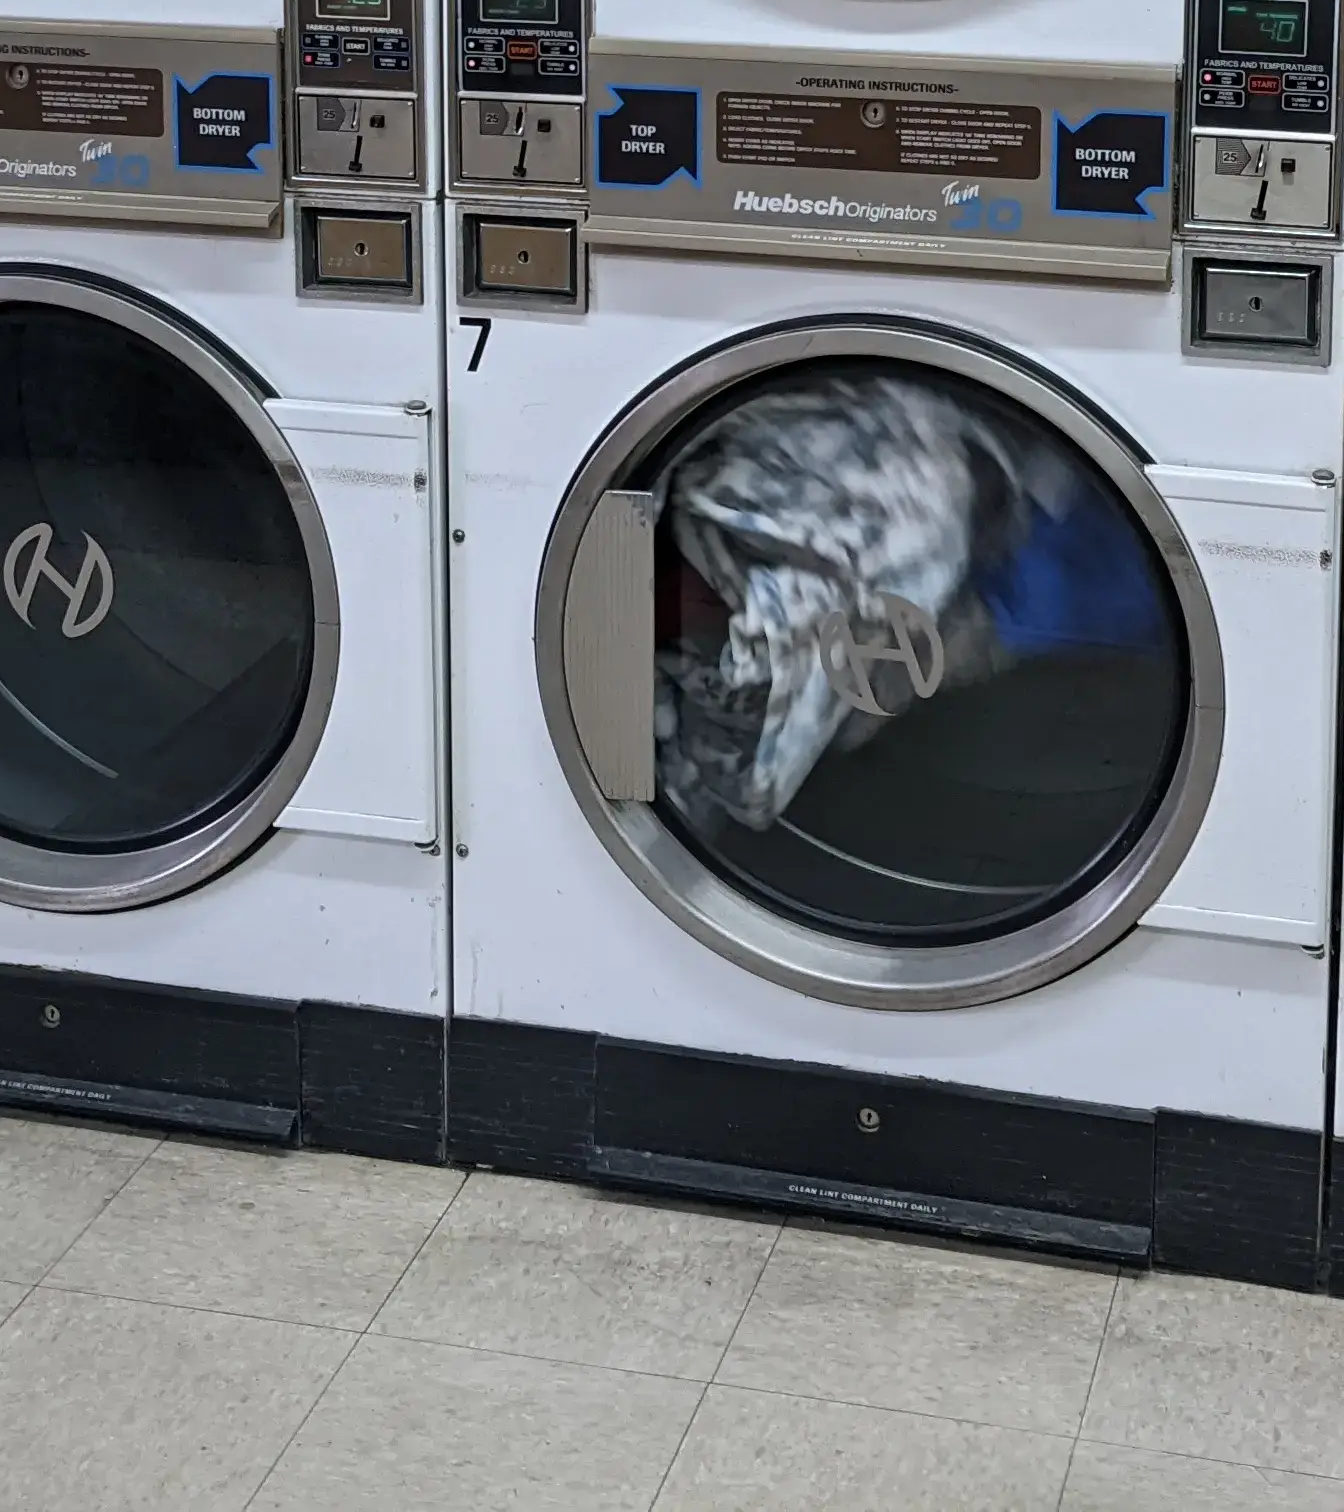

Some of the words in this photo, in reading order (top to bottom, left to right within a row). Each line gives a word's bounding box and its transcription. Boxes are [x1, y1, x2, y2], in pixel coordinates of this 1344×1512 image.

[468, 27, 498, 35] FABRICS
[500, 28, 515, 36] AND
[1260, 21, 1295, 42] 40
[1204, 59, 1238, 68] FABRICS
[1241, 61, 1258, 69] AND
[1259, 62, 1323, 73] TEMPERATURES
[1252, 81, 1277, 89] START
[193, 107, 246, 122] BOTTOM
[323, 110, 335, 119] 25
[486, 114, 499, 124] 25
[199, 123, 241, 137] DRYER
[630, 125, 656, 137] TOP
[79, 140, 112, 163] Twin
[621, 140, 665, 155] DRYER
[1075, 149, 1136, 163] BOTTOM
[1223, 152, 1237, 162] 25
[1081, 166, 1129, 180] DRYER
[941, 181, 980, 207] Twin
[460, 317, 491, 371] 7
[789, 1184, 817, 1194] CLEAN
[819, 1189, 840, 1198] LINT
[841, 1192, 909, 1209] COMPARTMENT
[911, 1203, 938, 1213] DAILY
